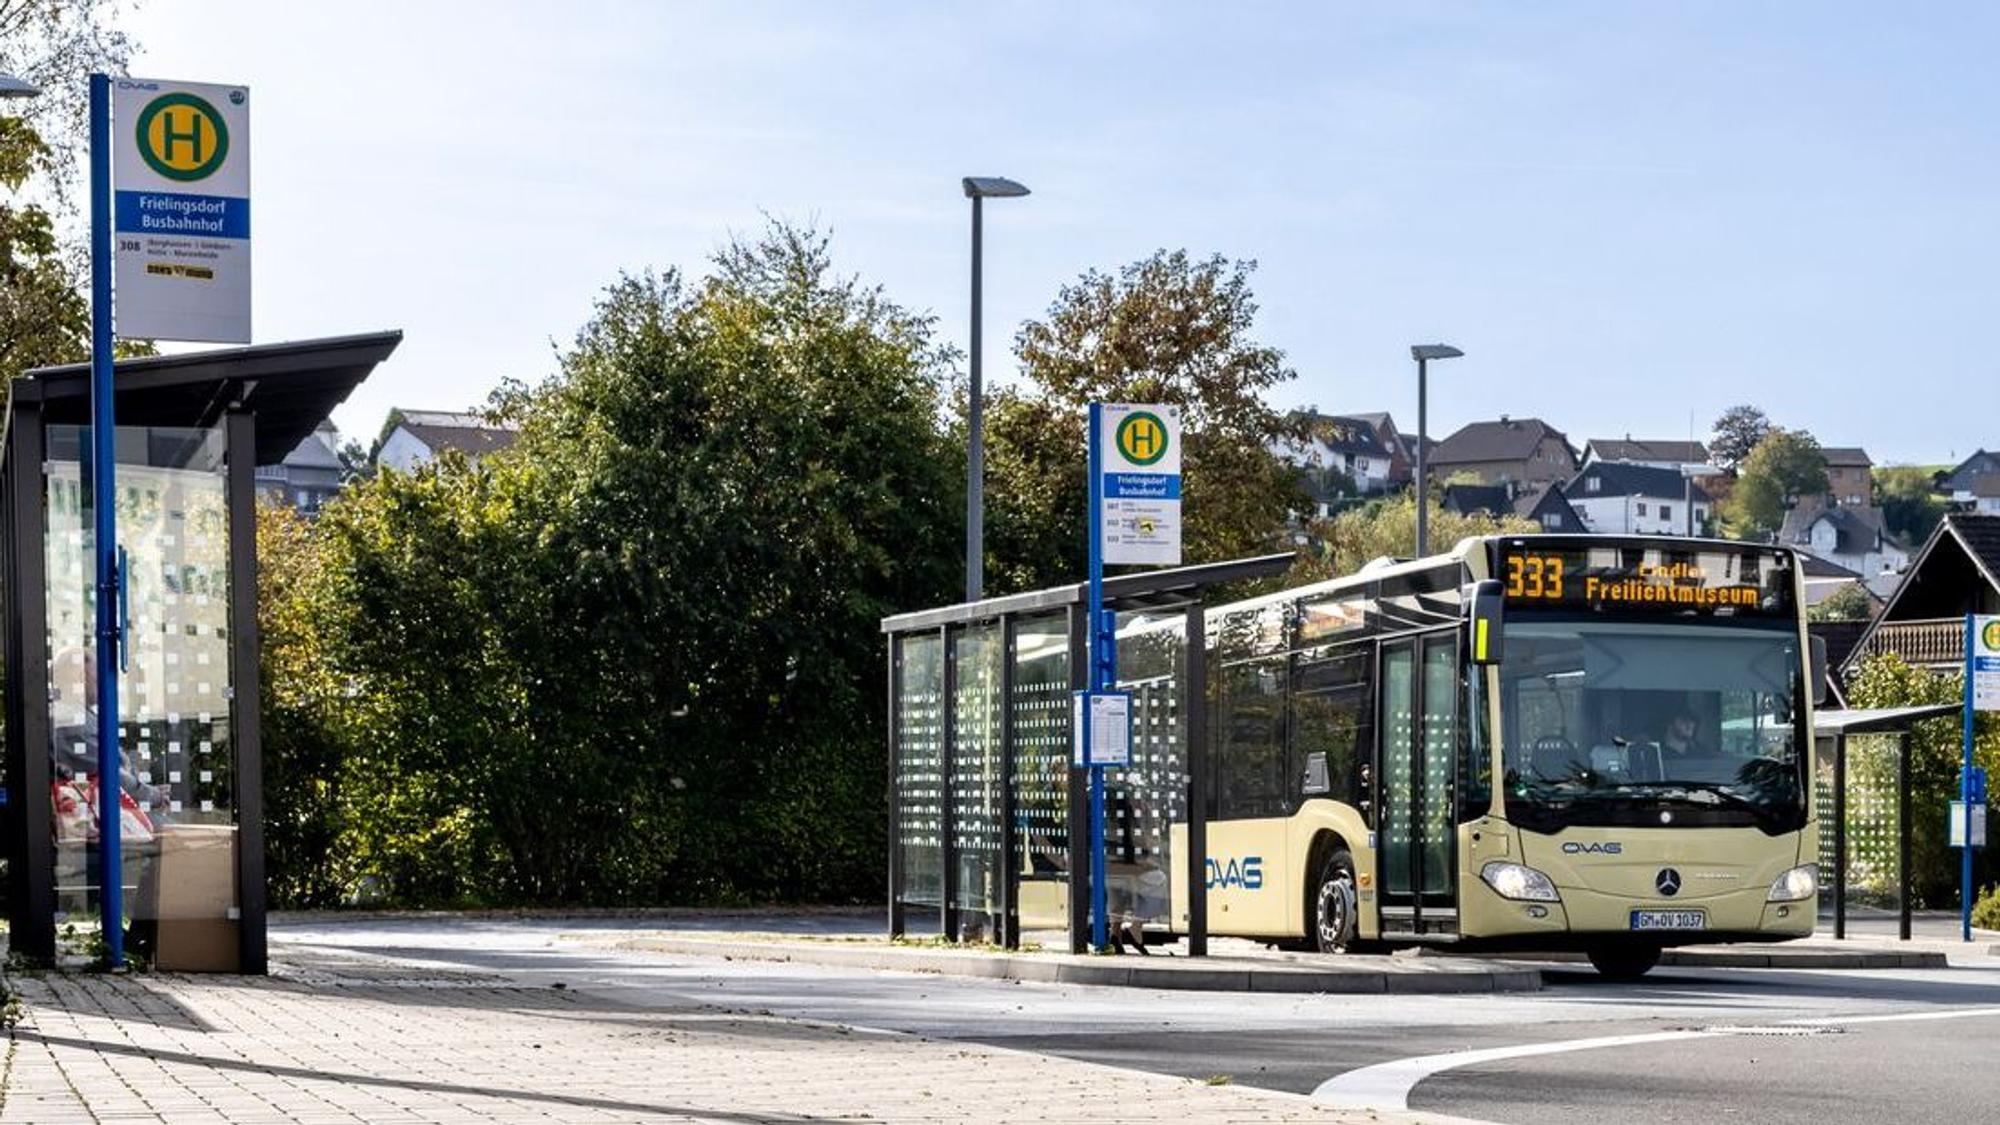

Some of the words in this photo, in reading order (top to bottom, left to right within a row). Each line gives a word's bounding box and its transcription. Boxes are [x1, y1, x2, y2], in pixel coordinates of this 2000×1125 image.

[164, 112, 201, 162] H
[140, 196, 226, 215] Frielingsdorf
[142, 215, 223, 232] Busbahnhof
[120, 241, 141, 251] 308
[1132, 423, 1154, 455] H
[1118, 475, 1167, 487] Frielingsdorf
[1119, 486, 1167, 496] Busbahnhof
[1507, 556, 1563, 598] 333
[1586, 577, 1758, 606] Freilichtmuseum
[1562, 842, 1622, 854] OVAG
[1676, 913, 1702, 927] 1037
